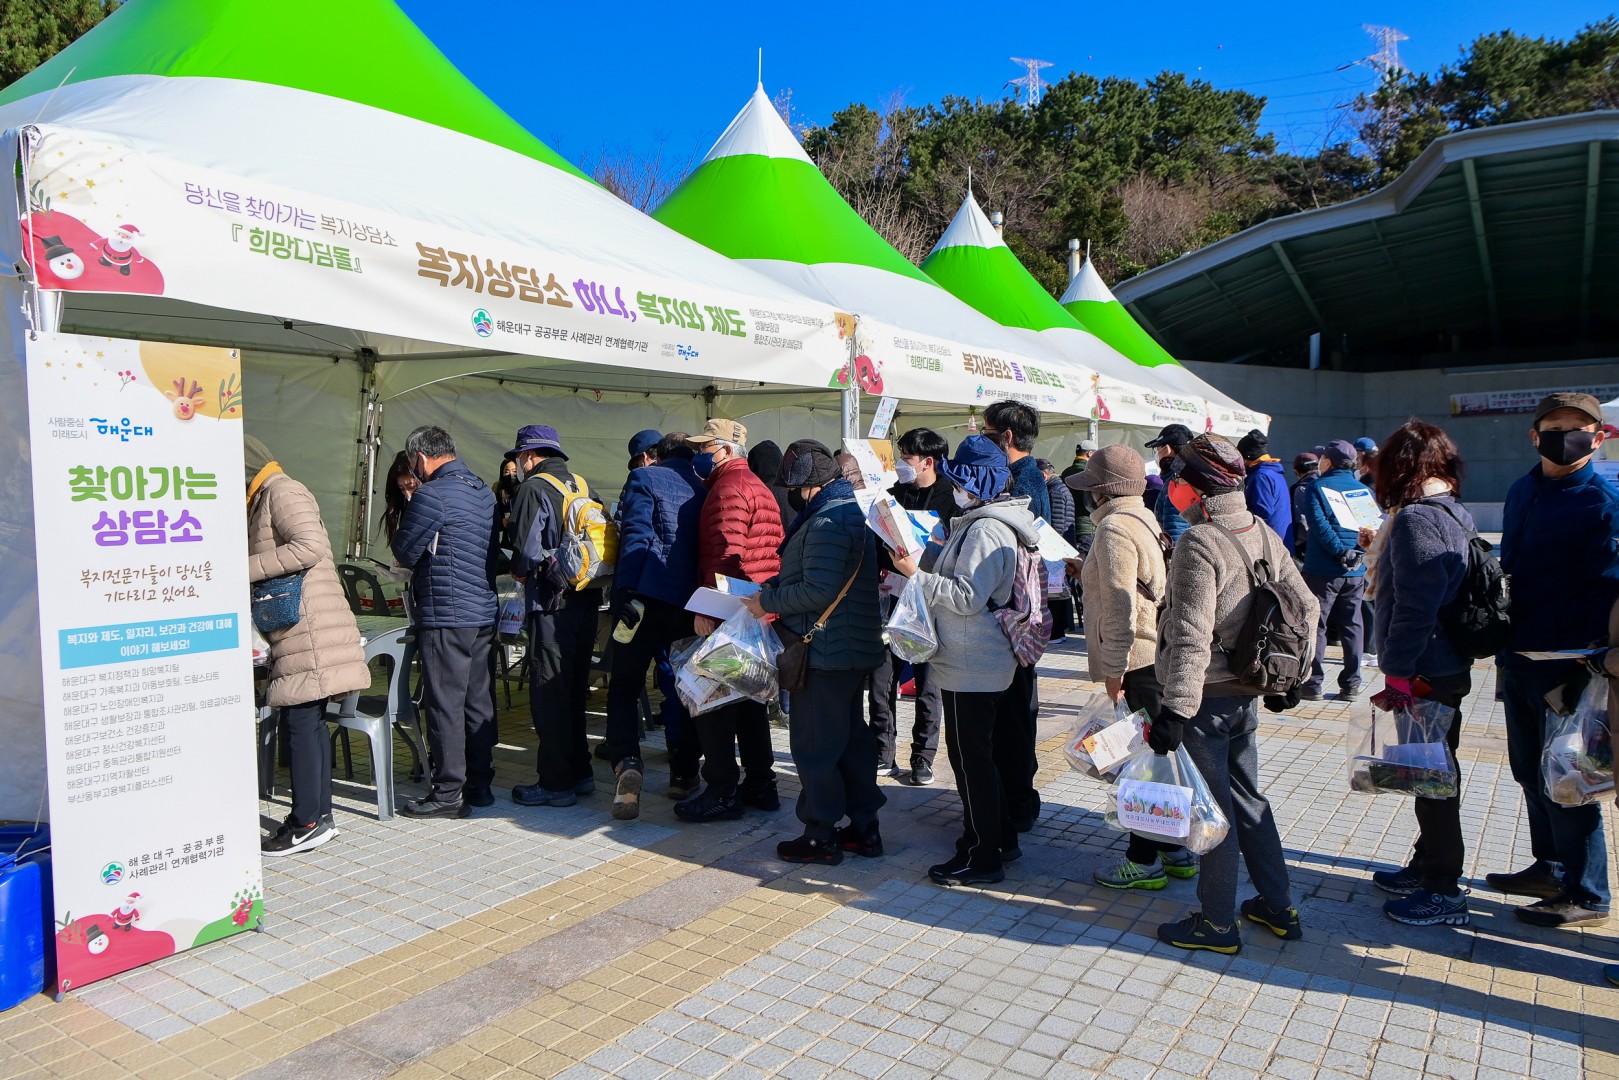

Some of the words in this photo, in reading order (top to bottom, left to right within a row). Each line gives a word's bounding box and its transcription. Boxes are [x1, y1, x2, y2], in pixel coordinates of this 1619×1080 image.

[184, 182, 242, 214] 당신을
[246, 196, 316, 231] 찾아가는
[320, 214, 398, 248] 복지상담소
[415, 241, 574, 309] 복지상담소
[572, 278, 638, 323] 하나,
[636, 290, 705, 332] 복지와
[704, 305, 747, 338] 제도
[496, 320, 532, 336] 해운대구
[534, 325, 568, 342] 공공부문
[571, 331, 602, 347] 사례관리
[604, 336, 648, 353] 연계협력기관
[962, 352, 1012, 380] 복지상담소
[48, 417, 84, 428] 사람중심
[52, 429, 88, 440] 미래도시
[89, 418, 153, 442] 해운대
[68, 464, 218, 502] 찾아가는
[92, 509, 204, 546] 상담소
[80, 565, 171, 588] 복지전문가들이
[176, 560, 212, 582] 당신을
[104, 588, 157, 602] 기다리고
[162, 585, 200, 602] 있어요.
[67, 632, 98, 646] 복지와
[160, 622, 186, 636] 보건과
[188, 620, 214, 632] 건강에
[215, 618, 232, 630] 대해
[120, 644, 150, 657] 이야기
[151, 640, 190, 656] 해보세요!
[62, 675, 96, 687] 해운대구
[98, 668, 140, 682] 복지정책과
[141, 664, 180, 677] 희망복지팀
[62, 689, 97, 702] 해운대구
[184, 671, 220, 685] 드림스타트
[64, 704, 98, 716] 해운대구
[64, 718, 98, 731] 해운대구
[100, 711, 142, 726] 생활보장과
[65, 728, 124, 746] 해운대구보건소
[126, 721, 166, 736] 건강증진과
[66, 746, 100, 760] 해운대구
[66, 761, 100, 775] 해운대구
[128, 847, 174, 867] 해운대구
[182, 834, 225, 854] 공공부문
[129, 861, 168, 880] 사례관리
[171, 846, 225, 869] 연계협력기관
